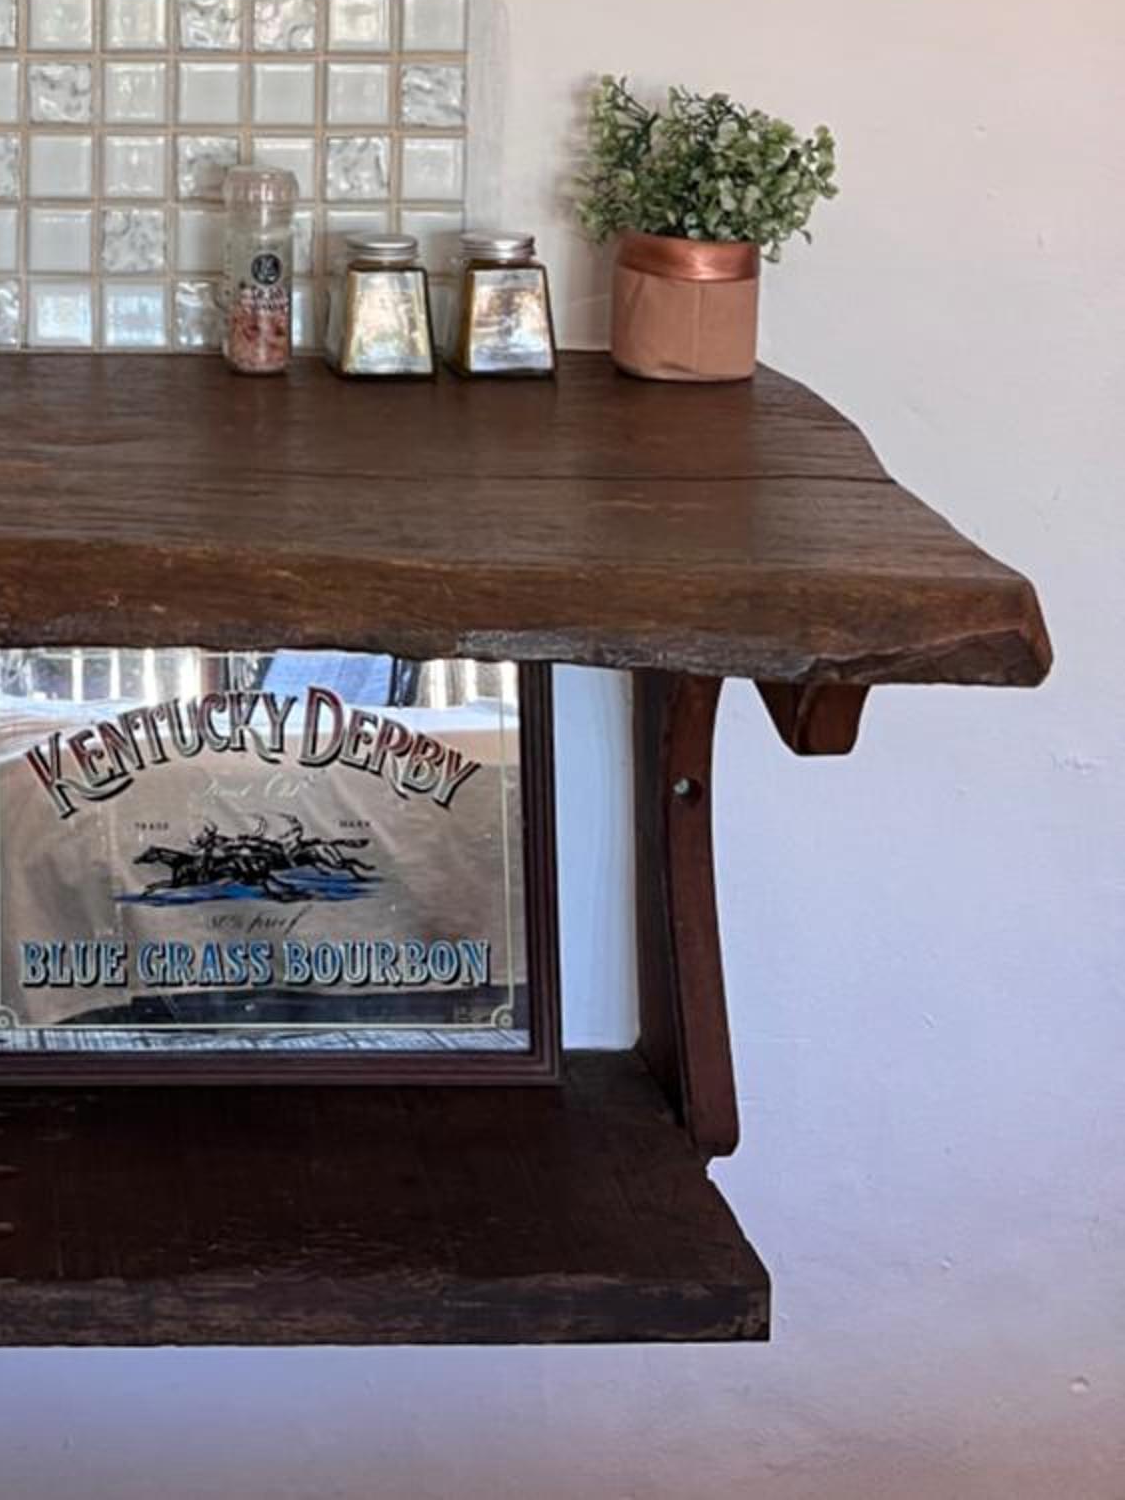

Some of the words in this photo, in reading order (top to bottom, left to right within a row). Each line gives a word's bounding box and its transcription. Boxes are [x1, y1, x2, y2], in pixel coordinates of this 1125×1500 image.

[25, 691, 297, 819] KENTUCKY
[299, 684, 481, 809] DERBY
[21, 939, 128, 988] BLUE
[137, 938, 274, 988] GRASS
[283, 938, 491, 988] BOURBON
